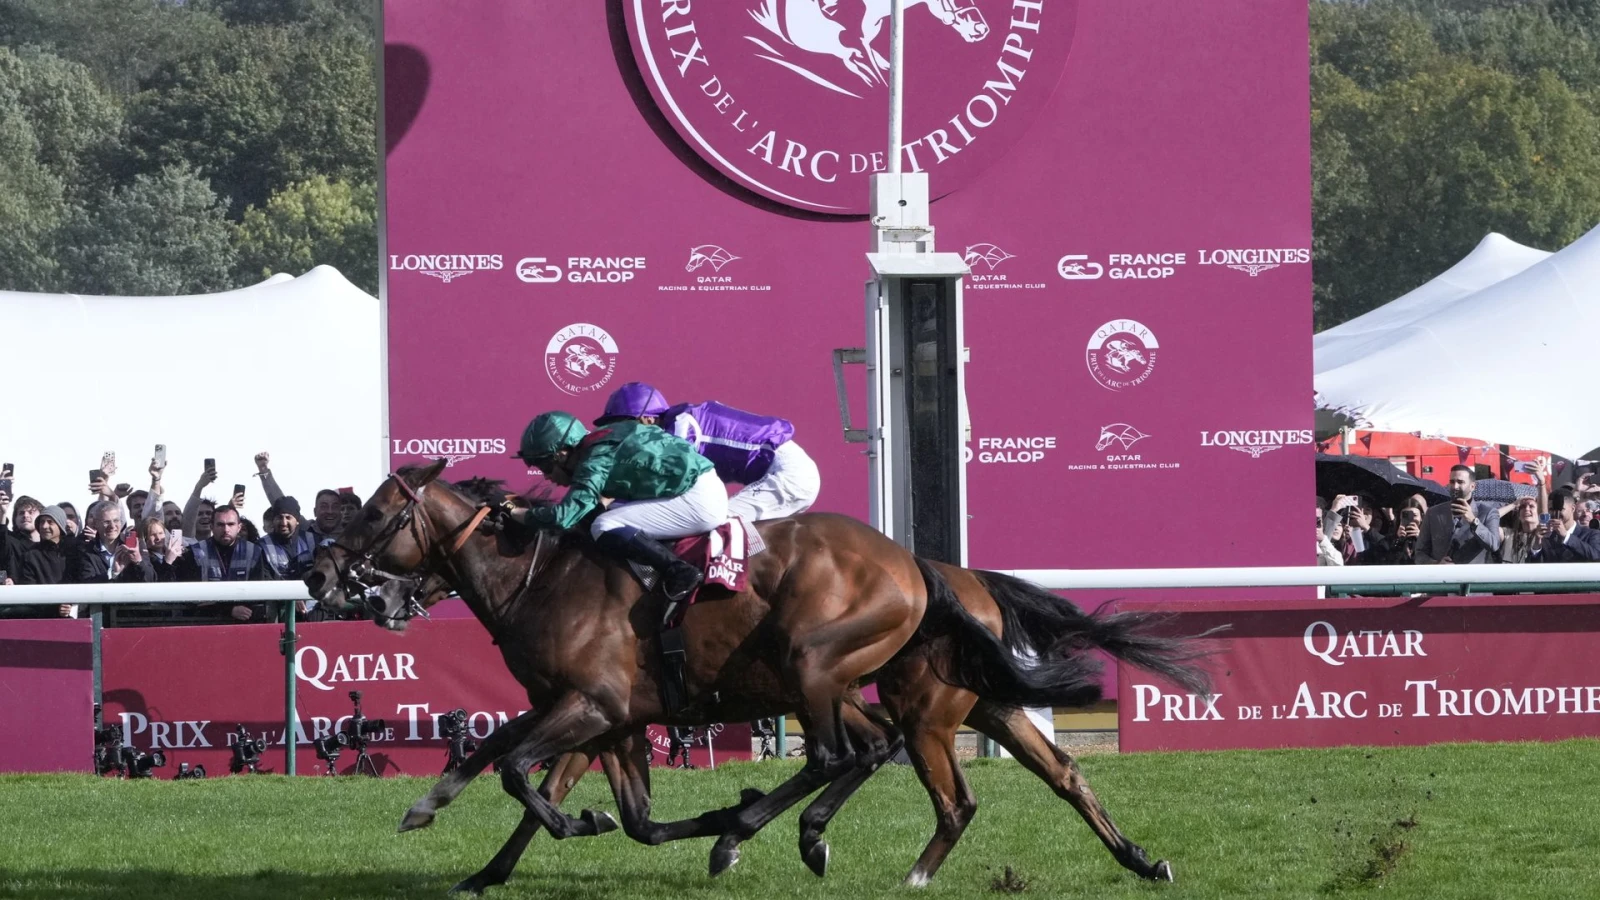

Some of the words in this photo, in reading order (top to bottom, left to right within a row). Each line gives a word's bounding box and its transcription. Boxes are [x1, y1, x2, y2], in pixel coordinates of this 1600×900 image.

[661, 0, 709, 78] RIX
[700, 75, 735, 116] DE
[850, 151, 888, 175] DE
[900, 0, 1043, 175] TRIOMPH
[390, 254, 504, 270] LONGINES
[567, 256, 646, 270] FRANCE
[1108, 252, 1187, 266] FRANCE
[1198, 248, 1311, 265] LONGINES
[567, 270, 635, 283] GALOP
[697, 276, 732, 284] QATAR
[971, 274, 1007, 282] QATAR
[1108, 266, 1175, 280] GALOP
[556, 325, 608, 343] QATAR
[1097, 321, 1148, 339] QATAR
[549, 356, 559, 376] PRIX
[589, 356, 616, 391] TRIOMPHE
[1090, 353, 1100, 372] PRIX
[1130, 351, 1156, 387] TRIOMPHE
[978, 436, 1057, 450] FRANCE
[1200, 429, 1313, 446] LONGINES
[392, 438, 506, 455] LONGINES
[978, 450, 1045, 464] GALOP
[1106, 454, 1141, 462] QATAR
[715, 554, 744, 572] TAR
[1303, 620, 1428, 666] QATAR
[295, 645, 419, 690] QATAR
[1132, 684, 1225, 722] PRIX
[1237, 705, 1263, 720] DE
[1271, 681, 1368, 720] L'ARC
[1378, 703, 1403, 718] DE
[1404, 679, 1600, 717] TRIOMPHE
[118, 711, 213, 749] PRIX
[649, 729, 671, 748] L'AR
